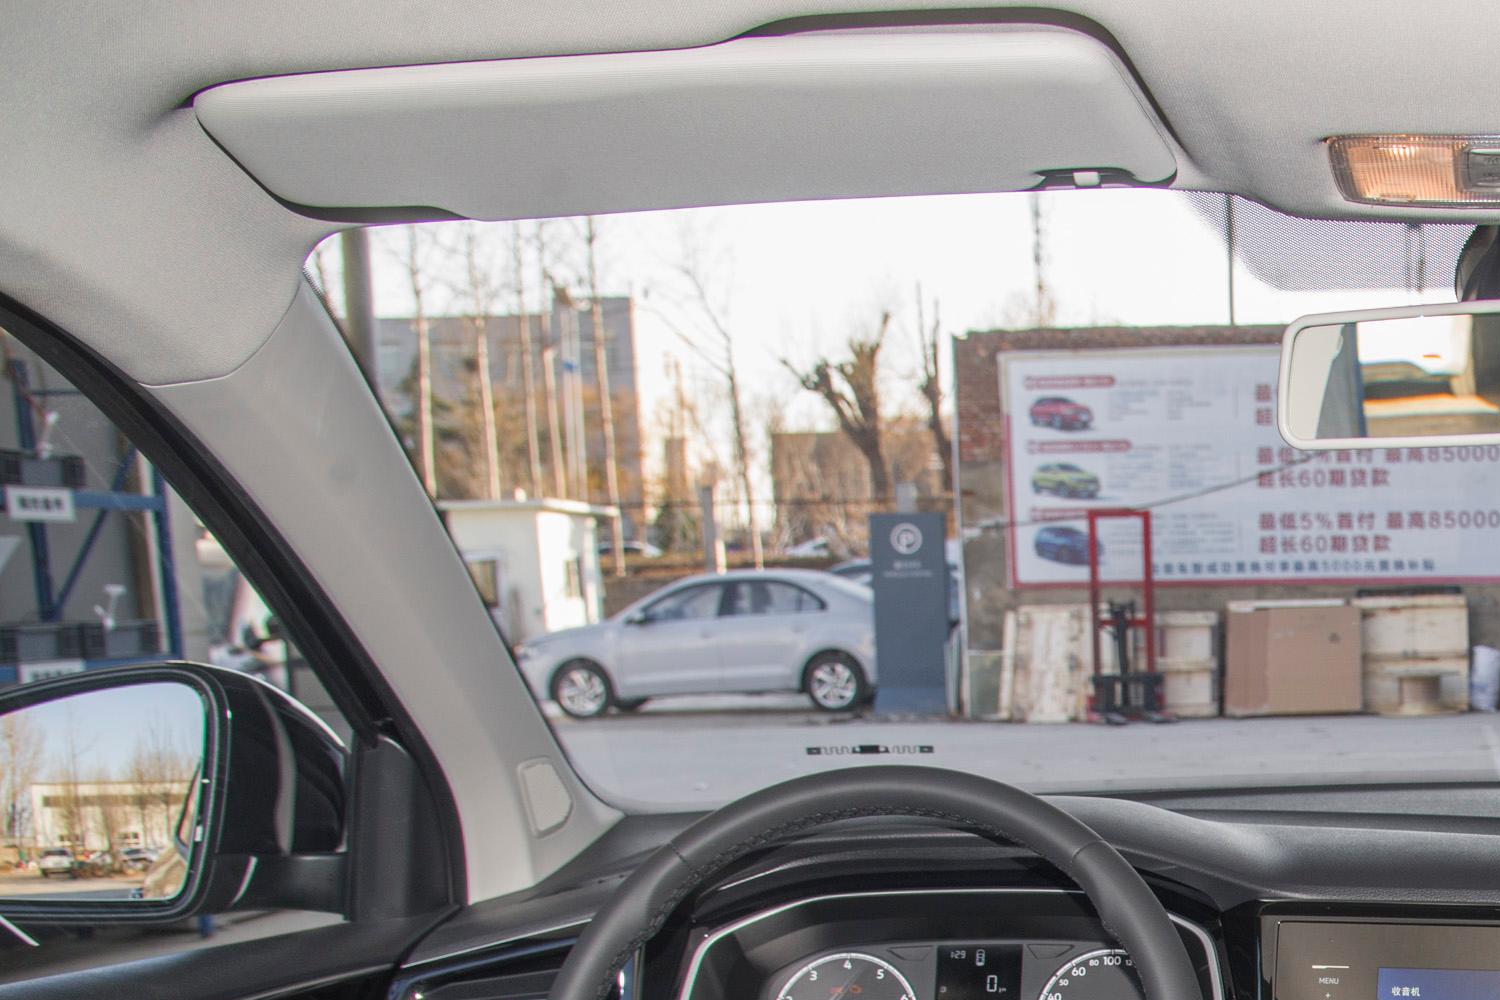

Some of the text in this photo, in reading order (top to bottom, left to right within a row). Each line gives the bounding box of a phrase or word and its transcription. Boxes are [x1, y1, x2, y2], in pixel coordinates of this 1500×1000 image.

[1259, 512, 1375, 531] 最低5%首付
[843, 960, 852, 970] 4
[1089, 959, 1099, 967] 80
[1103, 956, 1121, 966] 100
[809, 971, 818, 980] 3
[876, 969, 885, 979] 5
[1071, 967, 1086, 976] 60
[986, 975, 998, 992] 0
[1319, 977, 1340, 985] MENU
[1391, 986, 1421, 997] 收音机
